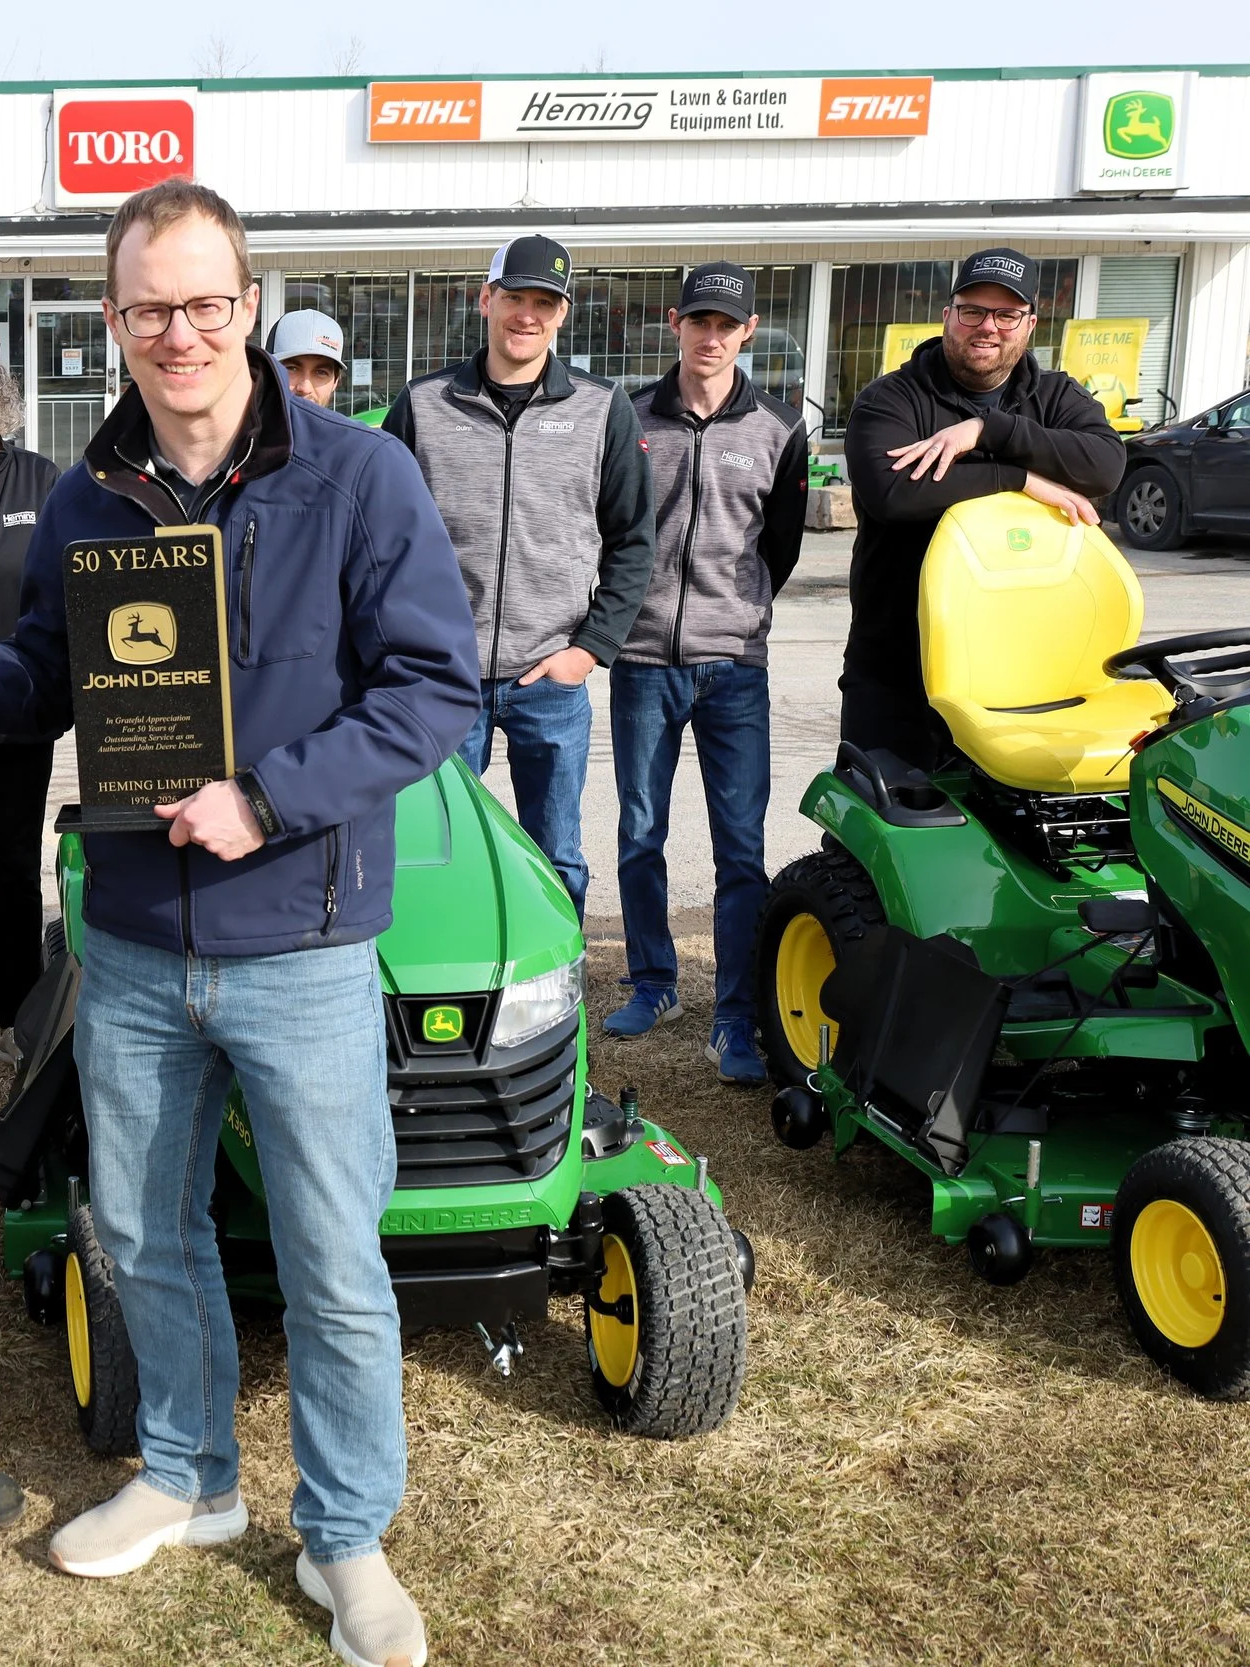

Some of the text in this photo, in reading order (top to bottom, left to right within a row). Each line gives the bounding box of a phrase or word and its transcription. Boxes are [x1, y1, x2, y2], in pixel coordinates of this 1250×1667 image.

[671, 89, 787, 106] Lawn & Garden
[373, 99, 475, 127] STIHL
[516, 92, 658, 131] Heming
[825, 95, 922, 120] STIHL
[671, 113, 784, 131] Equipment Ltd.
[1098, 166, 1172, 178] JOHN DEERE
[972, 256, 1025, 278] Heming
[694, 274, 744, 294] Heming
[1079, 331, 1134, 346] TAKE ME
[1086, 352, 1119, 365] FOR A
[538, 420, 575, 432] Heming
[721, 450, 755, 468] Heming
[2, 511, 36, 523] Heming
[72, 545, 208, 573] 50 YEARS
[83, 670, 211, 690] JOHN DEERE
[115, 716, 144, 725] Grateful
[146, 715, 191, 724] Appreciation
[168, 724, 177, 732] of
[104, 735, 147, 743] Outstanding
[148, 734, 174, 742] Service
[98, 744, 135, 752] Authorized
[99, 780, 153, 792] HEMING
[131, 796, 150, 805] 1976
[1181, 796, 1250, 858] JOHN DEERE
[228, 1103, 251, 1147] X390
[433, 1206, 532, 1230] DEERE
